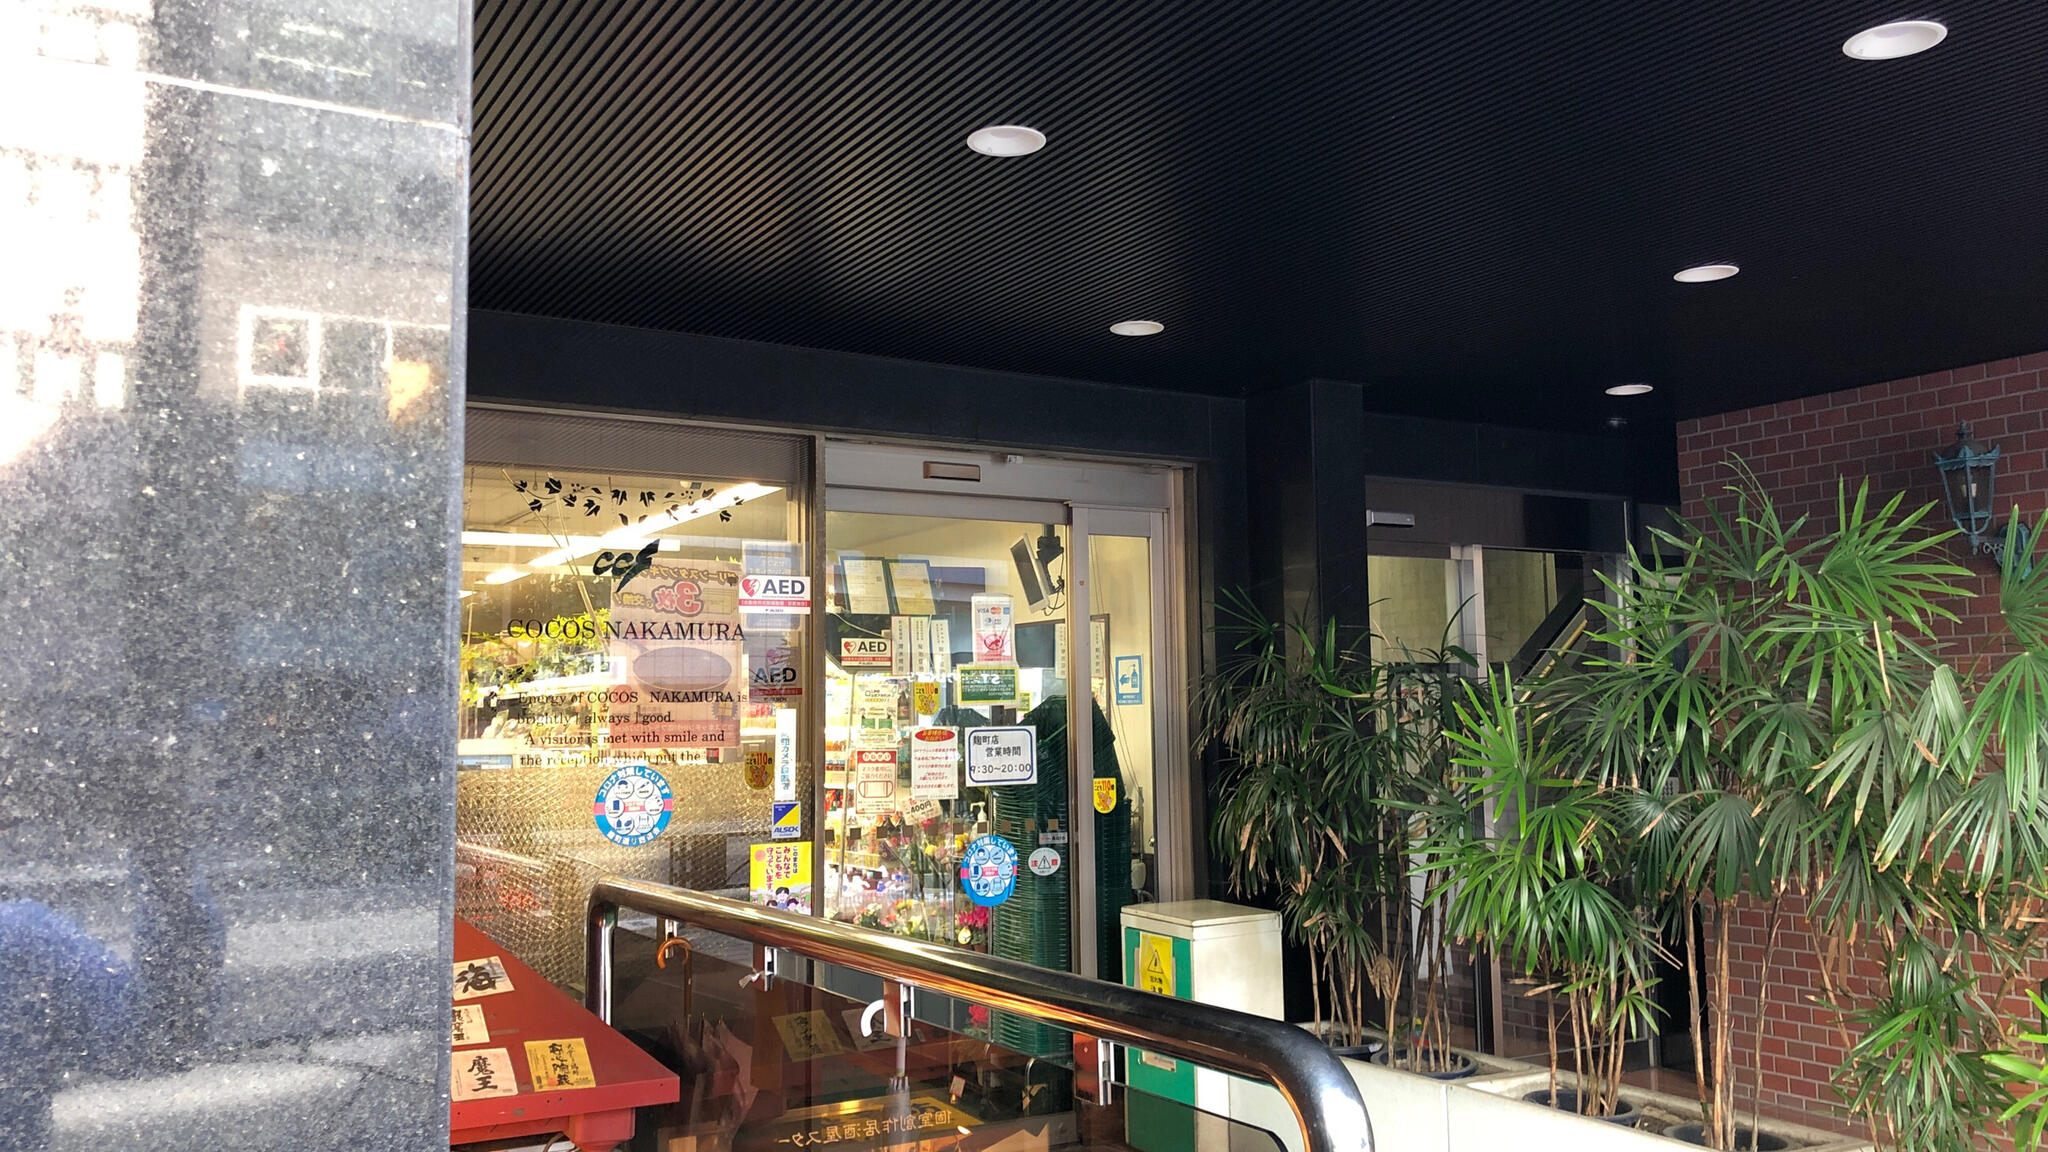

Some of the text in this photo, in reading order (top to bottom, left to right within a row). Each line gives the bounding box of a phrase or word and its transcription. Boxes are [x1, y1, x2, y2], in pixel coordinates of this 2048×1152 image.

[762, 579, 805, 595] AED
[507, 618, 747, 641] COCOS NAKAMURA
[858, 641, 887, 652] AED
[754, 667, 797, 683] AED
[519, 691, 747, 706] Energy of COCOS NAKAMURA is
[517, 711, 675, 731] brightly always good.
[525, 730, 725, 745] A visitor is met with smile and
[520, 753, 542, 766] the
[655, 751, 676, 766] put
[681, 751, 700, 761] the
[986, 746, 1021, 757] 営業時間
[783, 846, 791, 878] みんなで
[468, 1055, 498, 1092] 魔王
